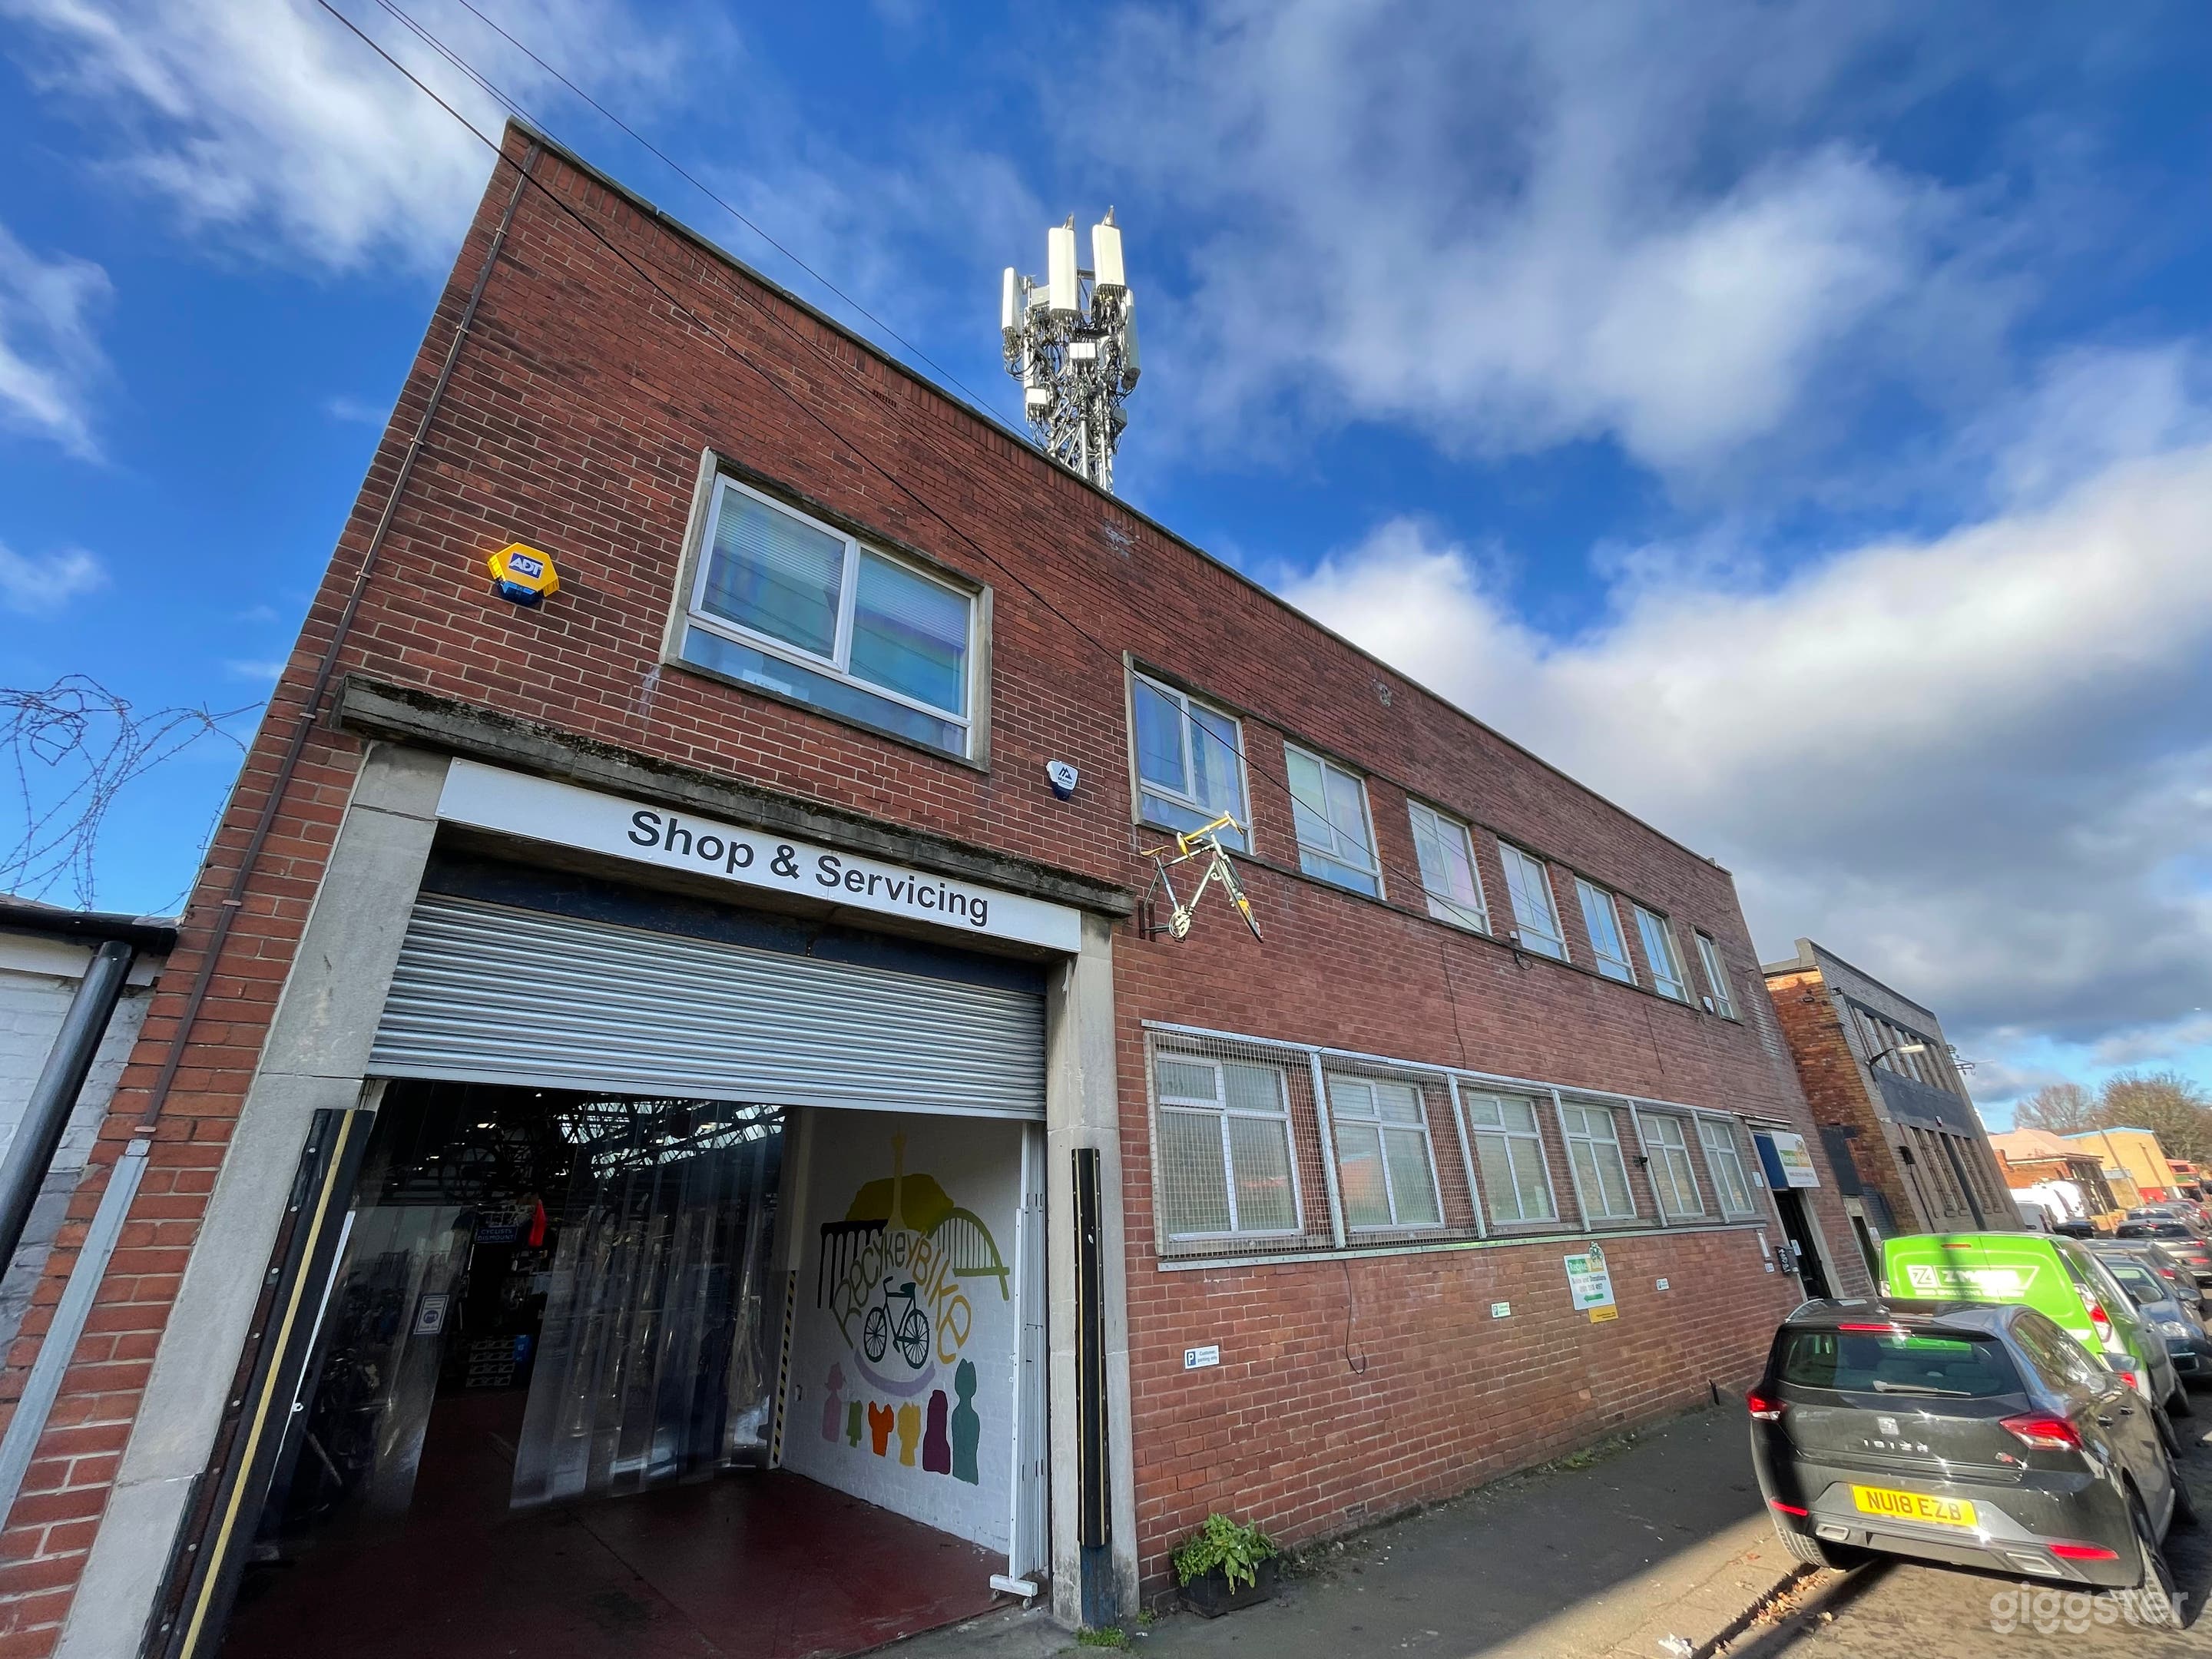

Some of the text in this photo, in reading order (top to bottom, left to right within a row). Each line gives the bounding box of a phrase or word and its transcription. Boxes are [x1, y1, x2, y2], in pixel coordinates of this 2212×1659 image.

[509, 557, 543, 575] ADT
[628, 810, 988, 927] Shop & Servicing
[1866, 1491, 1962, 1521] NU18 EZB
